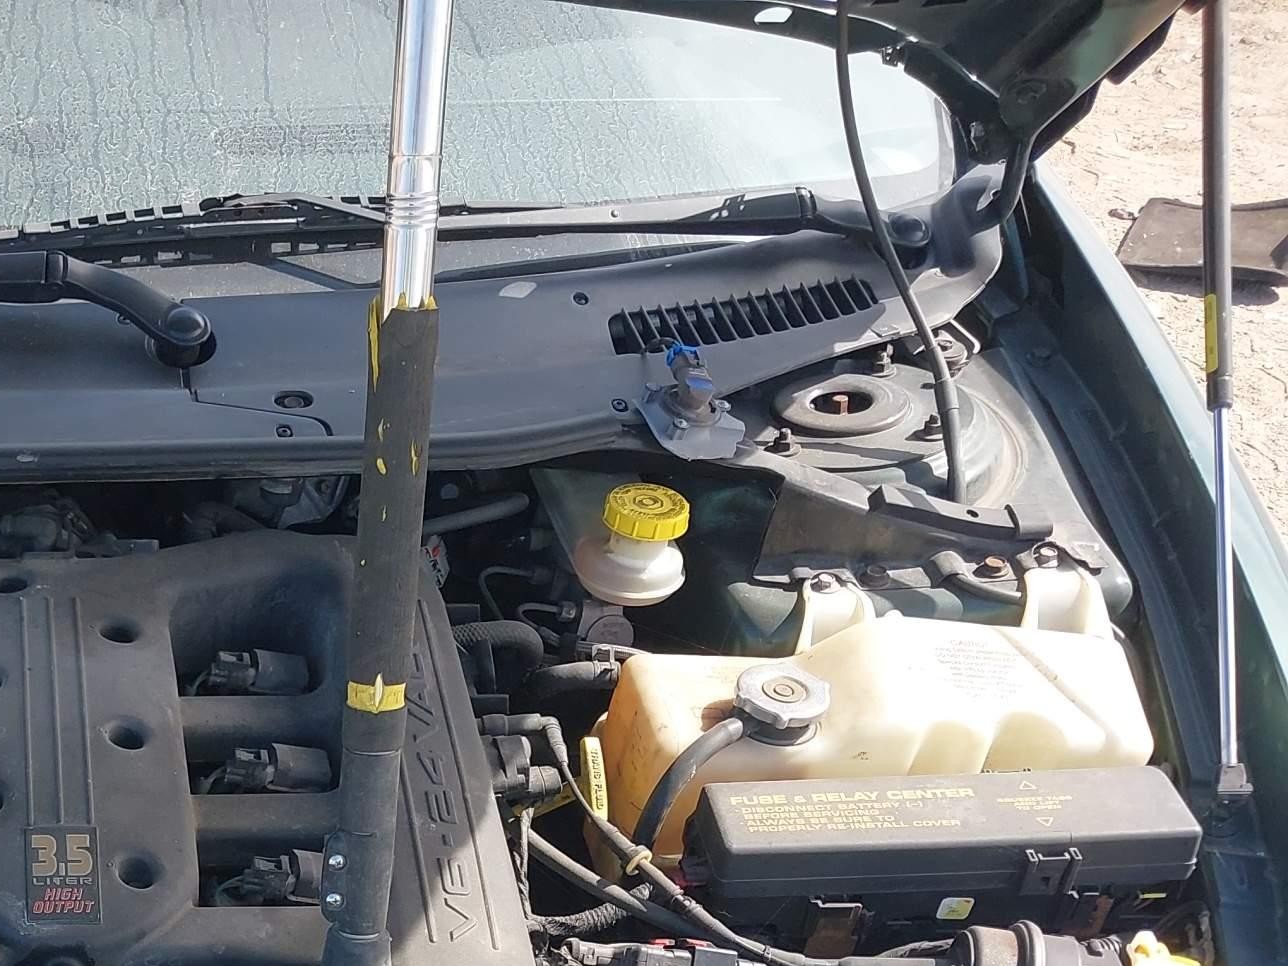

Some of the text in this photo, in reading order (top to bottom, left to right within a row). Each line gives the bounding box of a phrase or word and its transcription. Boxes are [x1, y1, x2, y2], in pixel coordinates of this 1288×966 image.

[729, 787, 975, 806] FUSE & RELAY CENTER
[839, 801, 900, 811] BATTERY
[744, 809, 881, 820] BEFORE SERVICING
[747, 814, 896, 826] ALWAYS BE SURE TO
[749, 823, 822, 833] PROPERLY
[913, 818, 962, 828] COVER
[31, 834, 93, 876] 3.5
[32, 877, 93, 886] LITER
[44, 887, 83, 901] HIGH
[32, 901, 95, 914] OUTPUT
